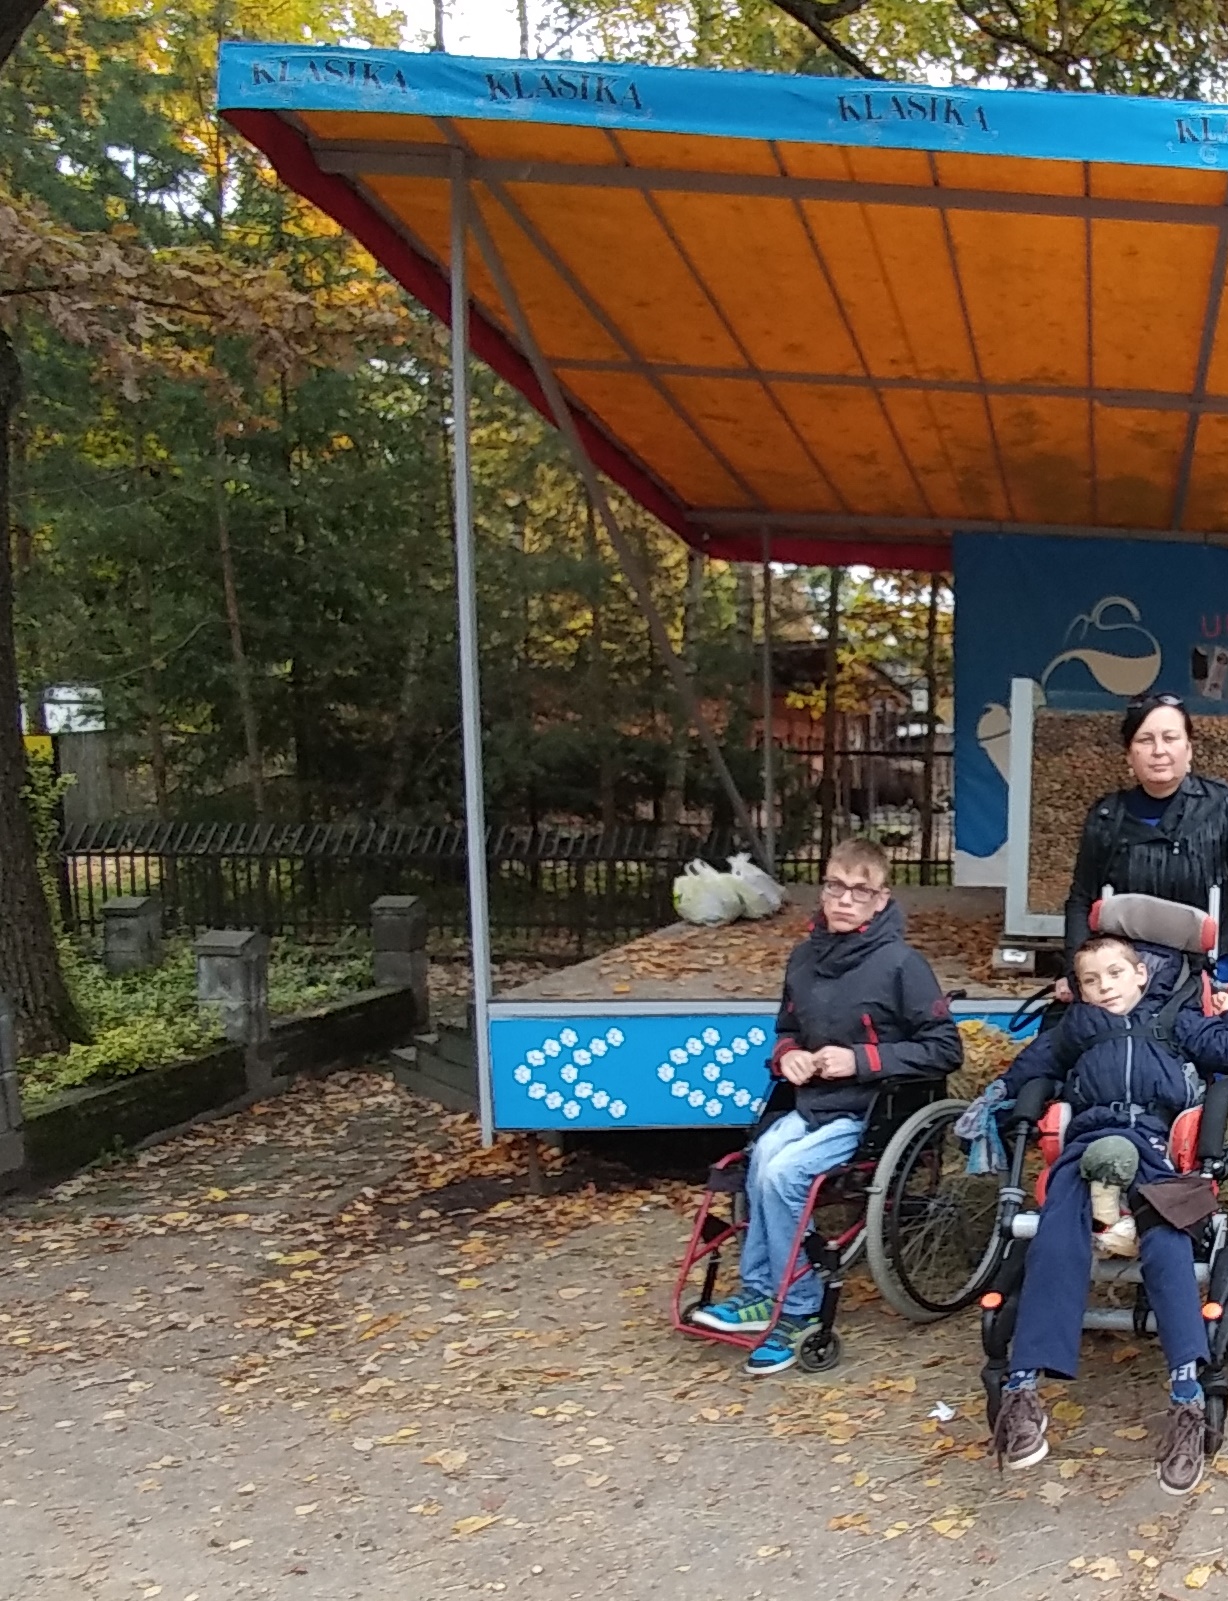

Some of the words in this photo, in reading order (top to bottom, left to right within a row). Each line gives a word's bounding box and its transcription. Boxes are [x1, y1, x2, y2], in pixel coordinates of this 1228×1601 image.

[252, 59, 408, 94] KLASIKA
[485, 71, 643, 110] KLASIKA
[837, 93, 990, 132] KLASIKA
